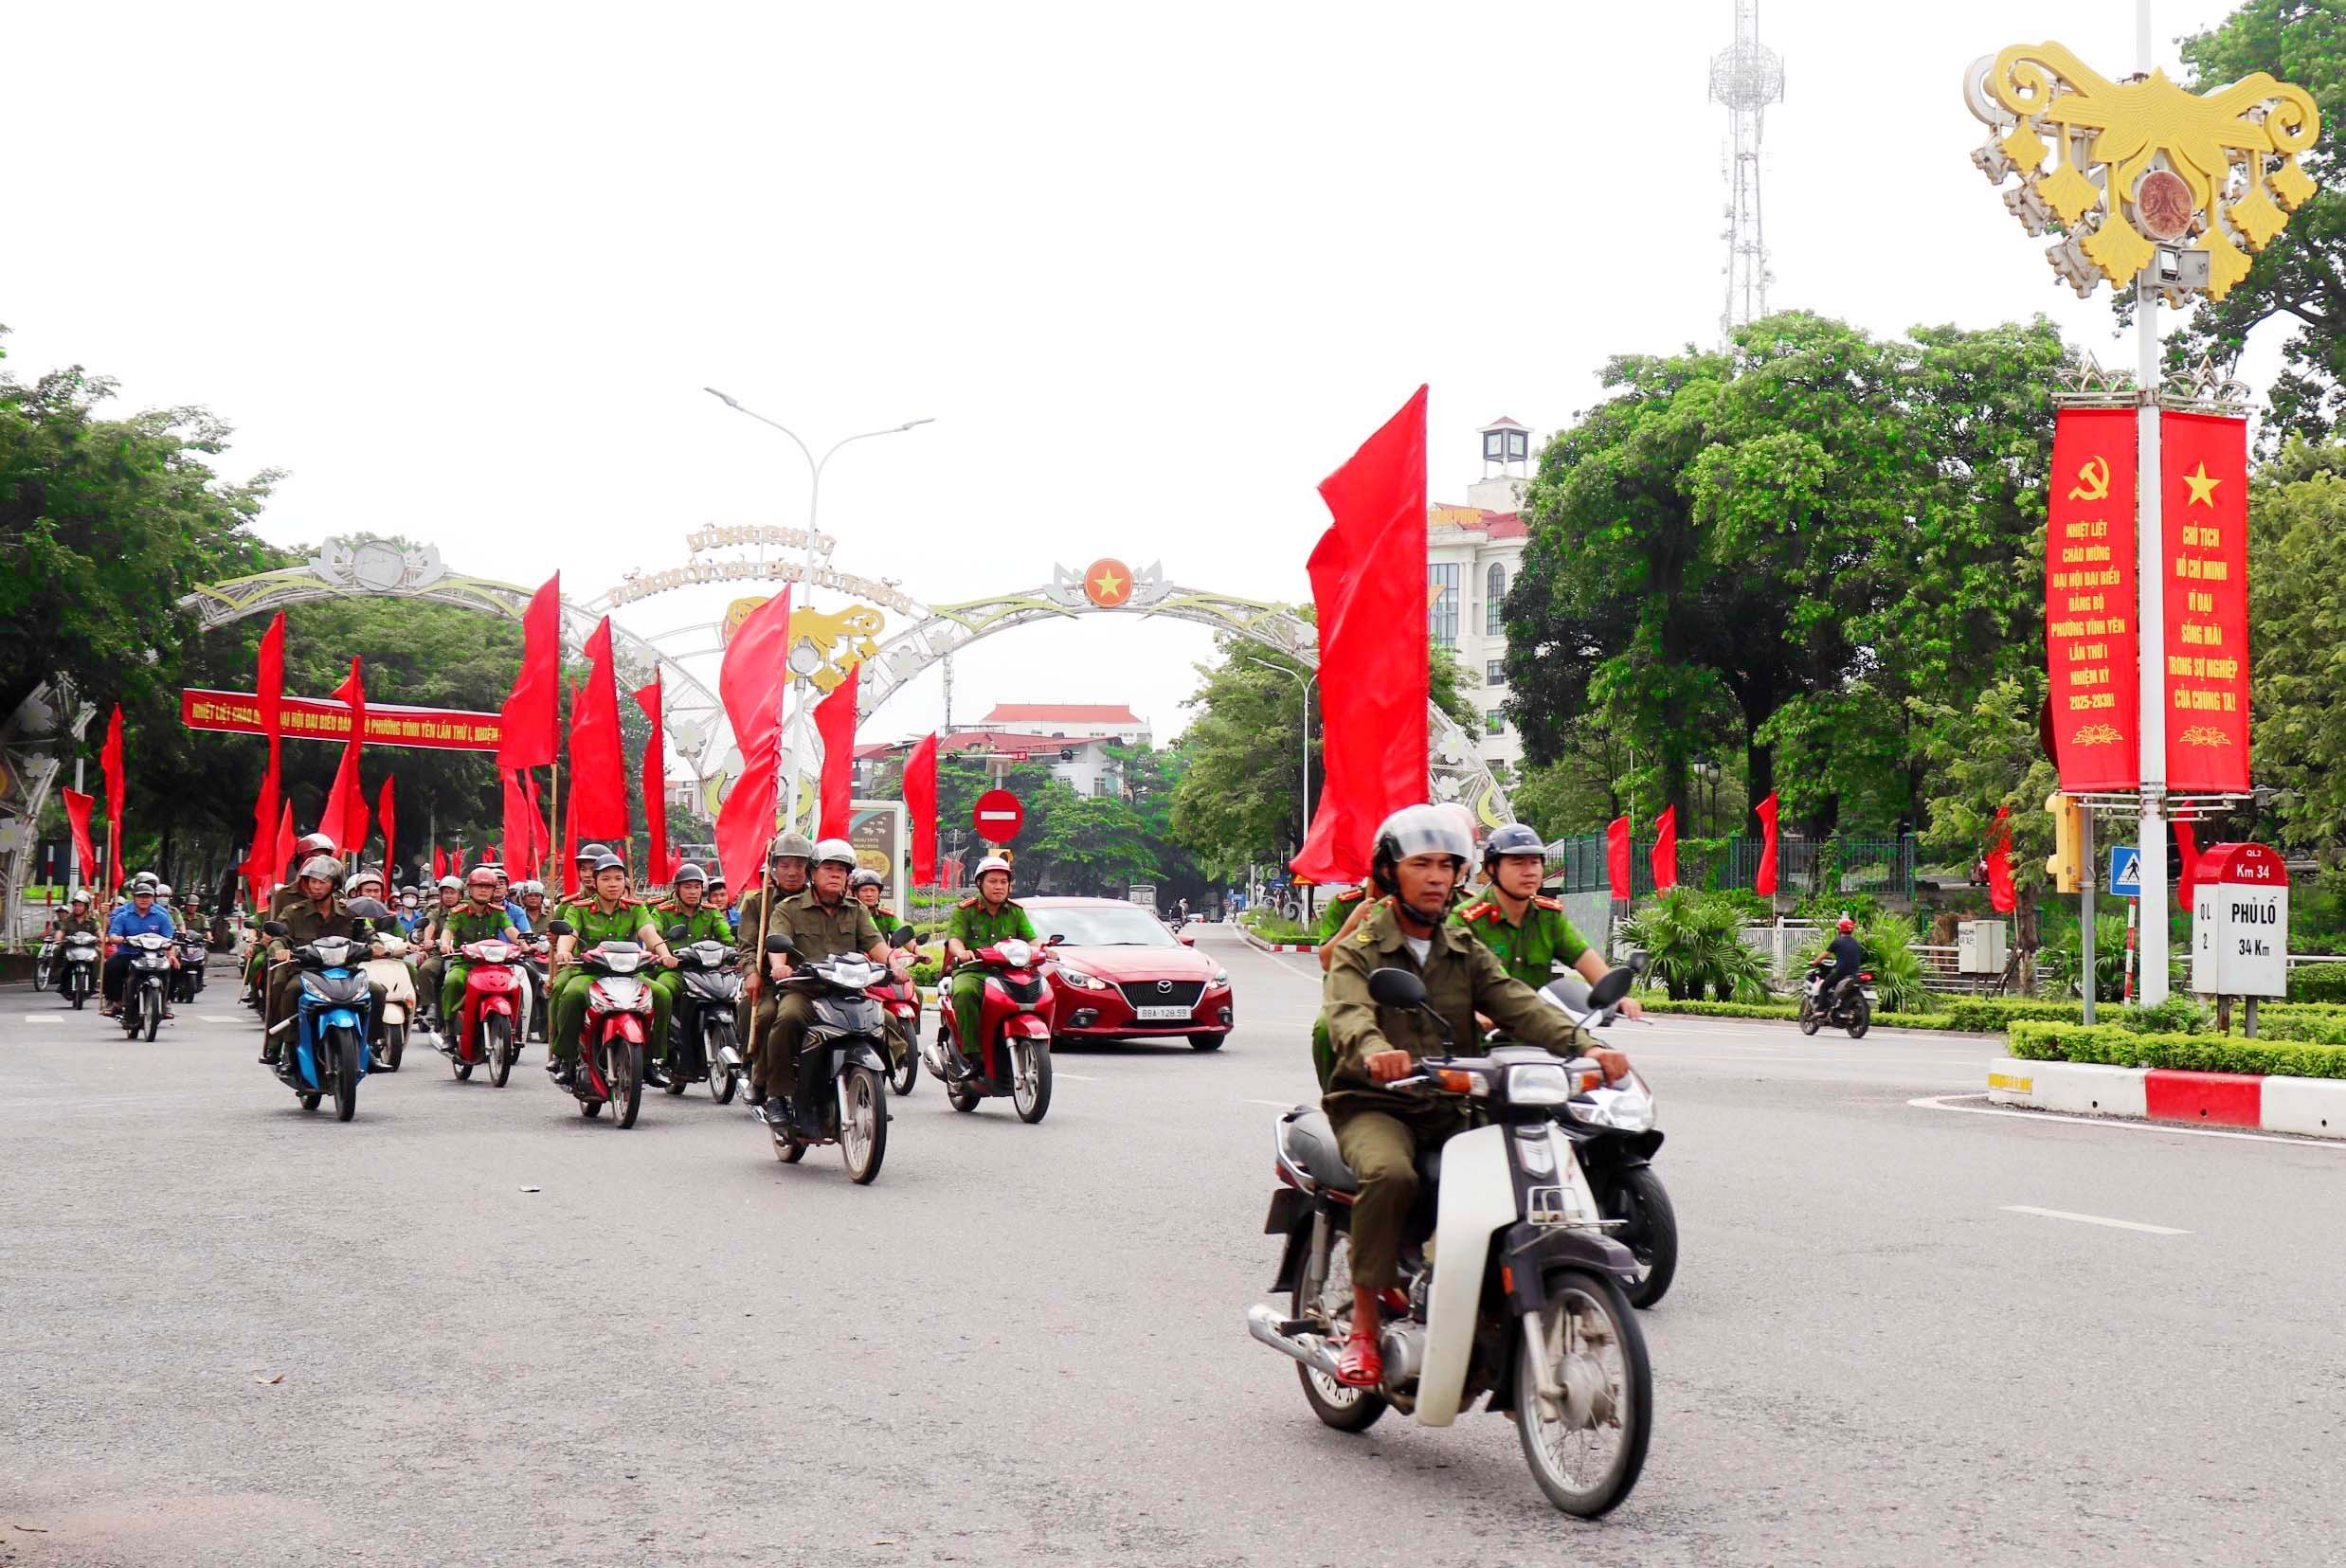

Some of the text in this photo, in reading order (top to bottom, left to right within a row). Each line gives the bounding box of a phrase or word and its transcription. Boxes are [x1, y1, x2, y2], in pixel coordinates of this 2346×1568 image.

[2066, 518, 2107, 541] NHIỆT LIỆT
[2183, 520, 2219, 551] CHỦ TỊCH
[2063, 544, 2111, 563] CHÀO MỪNG
[2053, 564, 2120, 591] ĐẠI HỘI ĐẠI BIỂU
[2188, 556, 2201, 579] CHÍ
[2203, 560, 2228, 581] MINH
[2068, 591, 2104, 613] ĐẢNG BỘ
[2189, 588, 2212, 616] VĨ ĐẠI
[2051, 617, 2125, 637] PHƯỜNG VĨNH YÊN
[2181, 618, 2222, 645] SỐNG MÃI
[2086, 641, 2102, 659] THỨ
[2070, 667, 2098, 688] NHIỆM
[2168, 656, 2238, 682] TRONG SỰ NGHIỆP
[2069, 693, 2115, 710] 2025-2030!
[2175, 683, 2236, 712] CỦA CHÚNG TA!
[192, 701, 215, 723] NHIỆT
[216, 703, 231, 724] LIỆT
[291, 710, 304, 731] HỘI
[305, 713, 318, 732] ĐẠI
[319, 709, 336, 730] BIỂU
[371, 716, 401, 736] PHƯỜNG
[403, 719, 420, 737] VĨNH
[422, 720, 436, 738] YÊN
[453, 722, 467, 740] THỨ
[475, 724, 498, 745] NHIỆM
[2247, 849, 2262, 857] QL2
[2237, 863, 2270, 879] Km 34
[2203, 933, 2209, 949] 2
[2239, 939, 2269, 956] 34 Km
